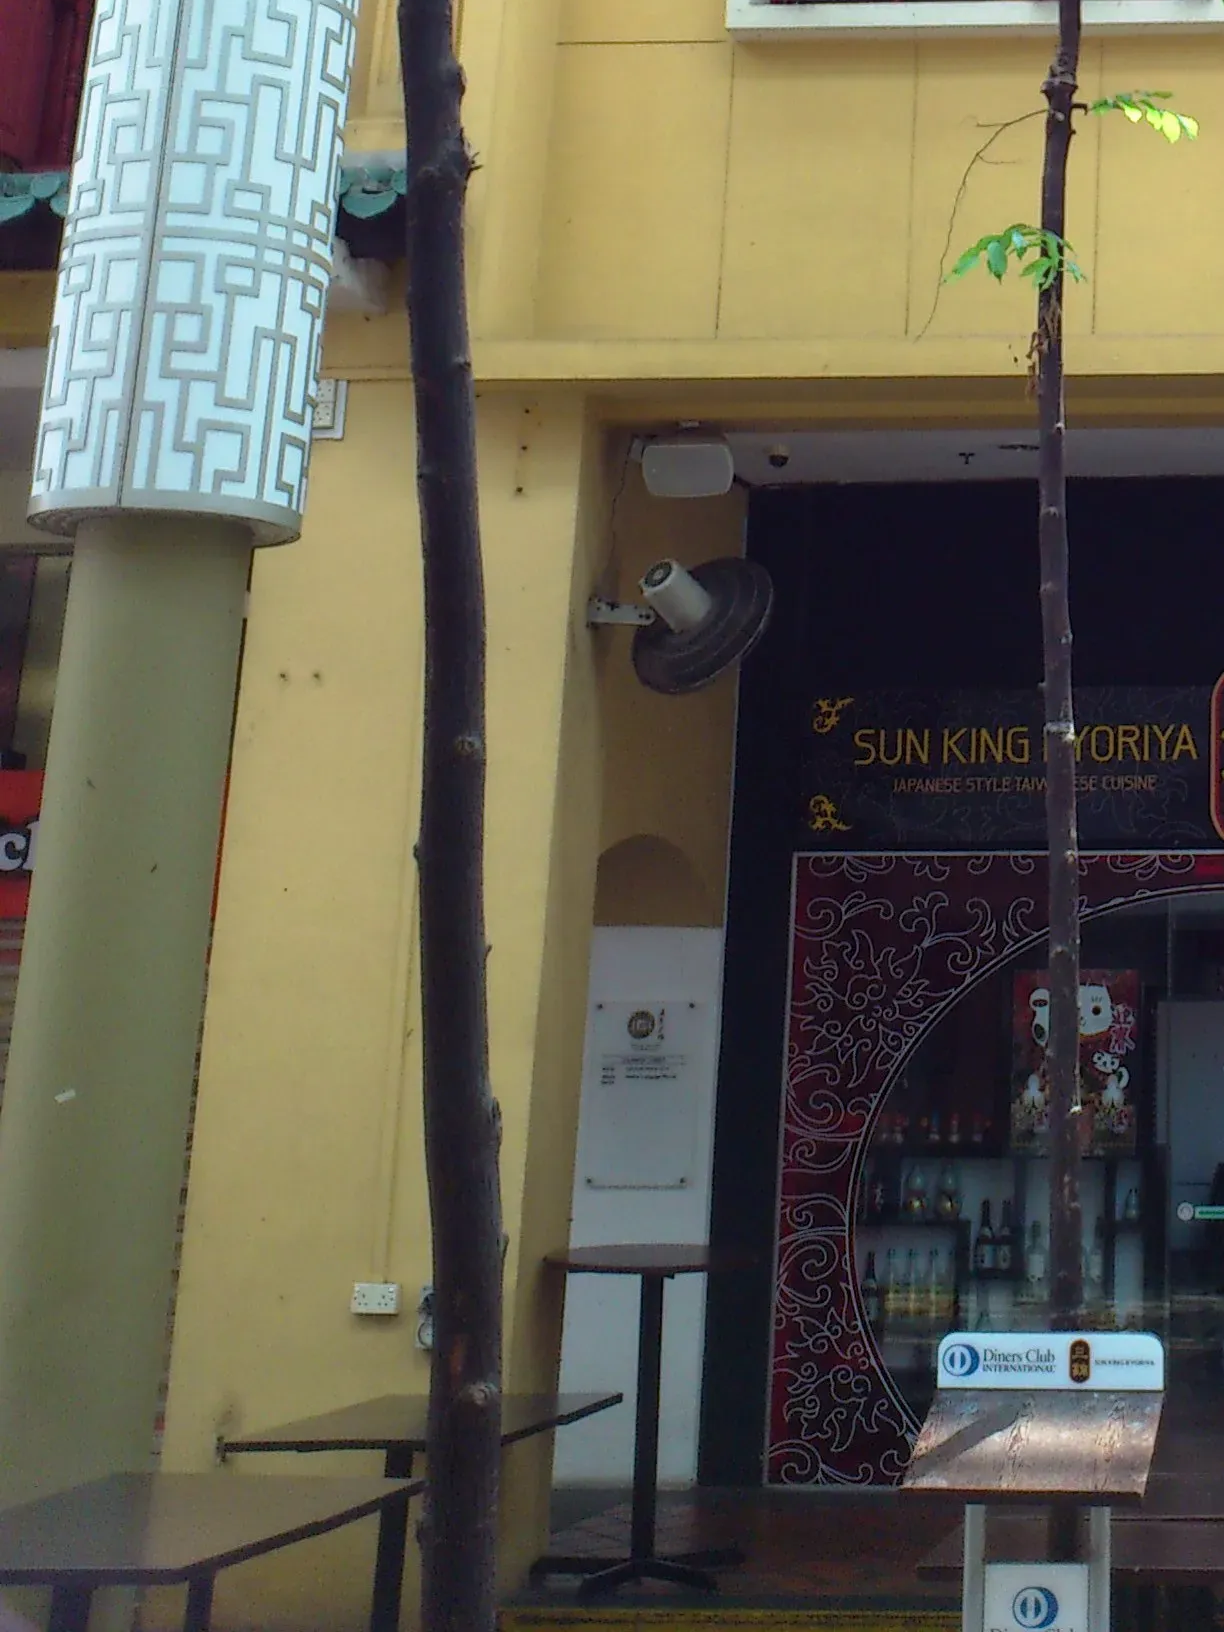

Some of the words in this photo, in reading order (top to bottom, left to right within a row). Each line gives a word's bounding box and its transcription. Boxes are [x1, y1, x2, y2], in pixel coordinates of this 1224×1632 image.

[854, 728, 930, 765] SUN
[943, 726, 1029, 764] KING
[1043, 724, 1199, 763] YORIYA
[893, 776, 961, 793] JAPANESE
[966, 776, 1011, 792] STYLE
[1101, 774, 1158, 792] CUISINE
[983, 1348, 1022, 1363] Diners
[1026, 1348, 1056, 1363] Club
[982, 1364, 1057, 1374] INTERNATIONAL
